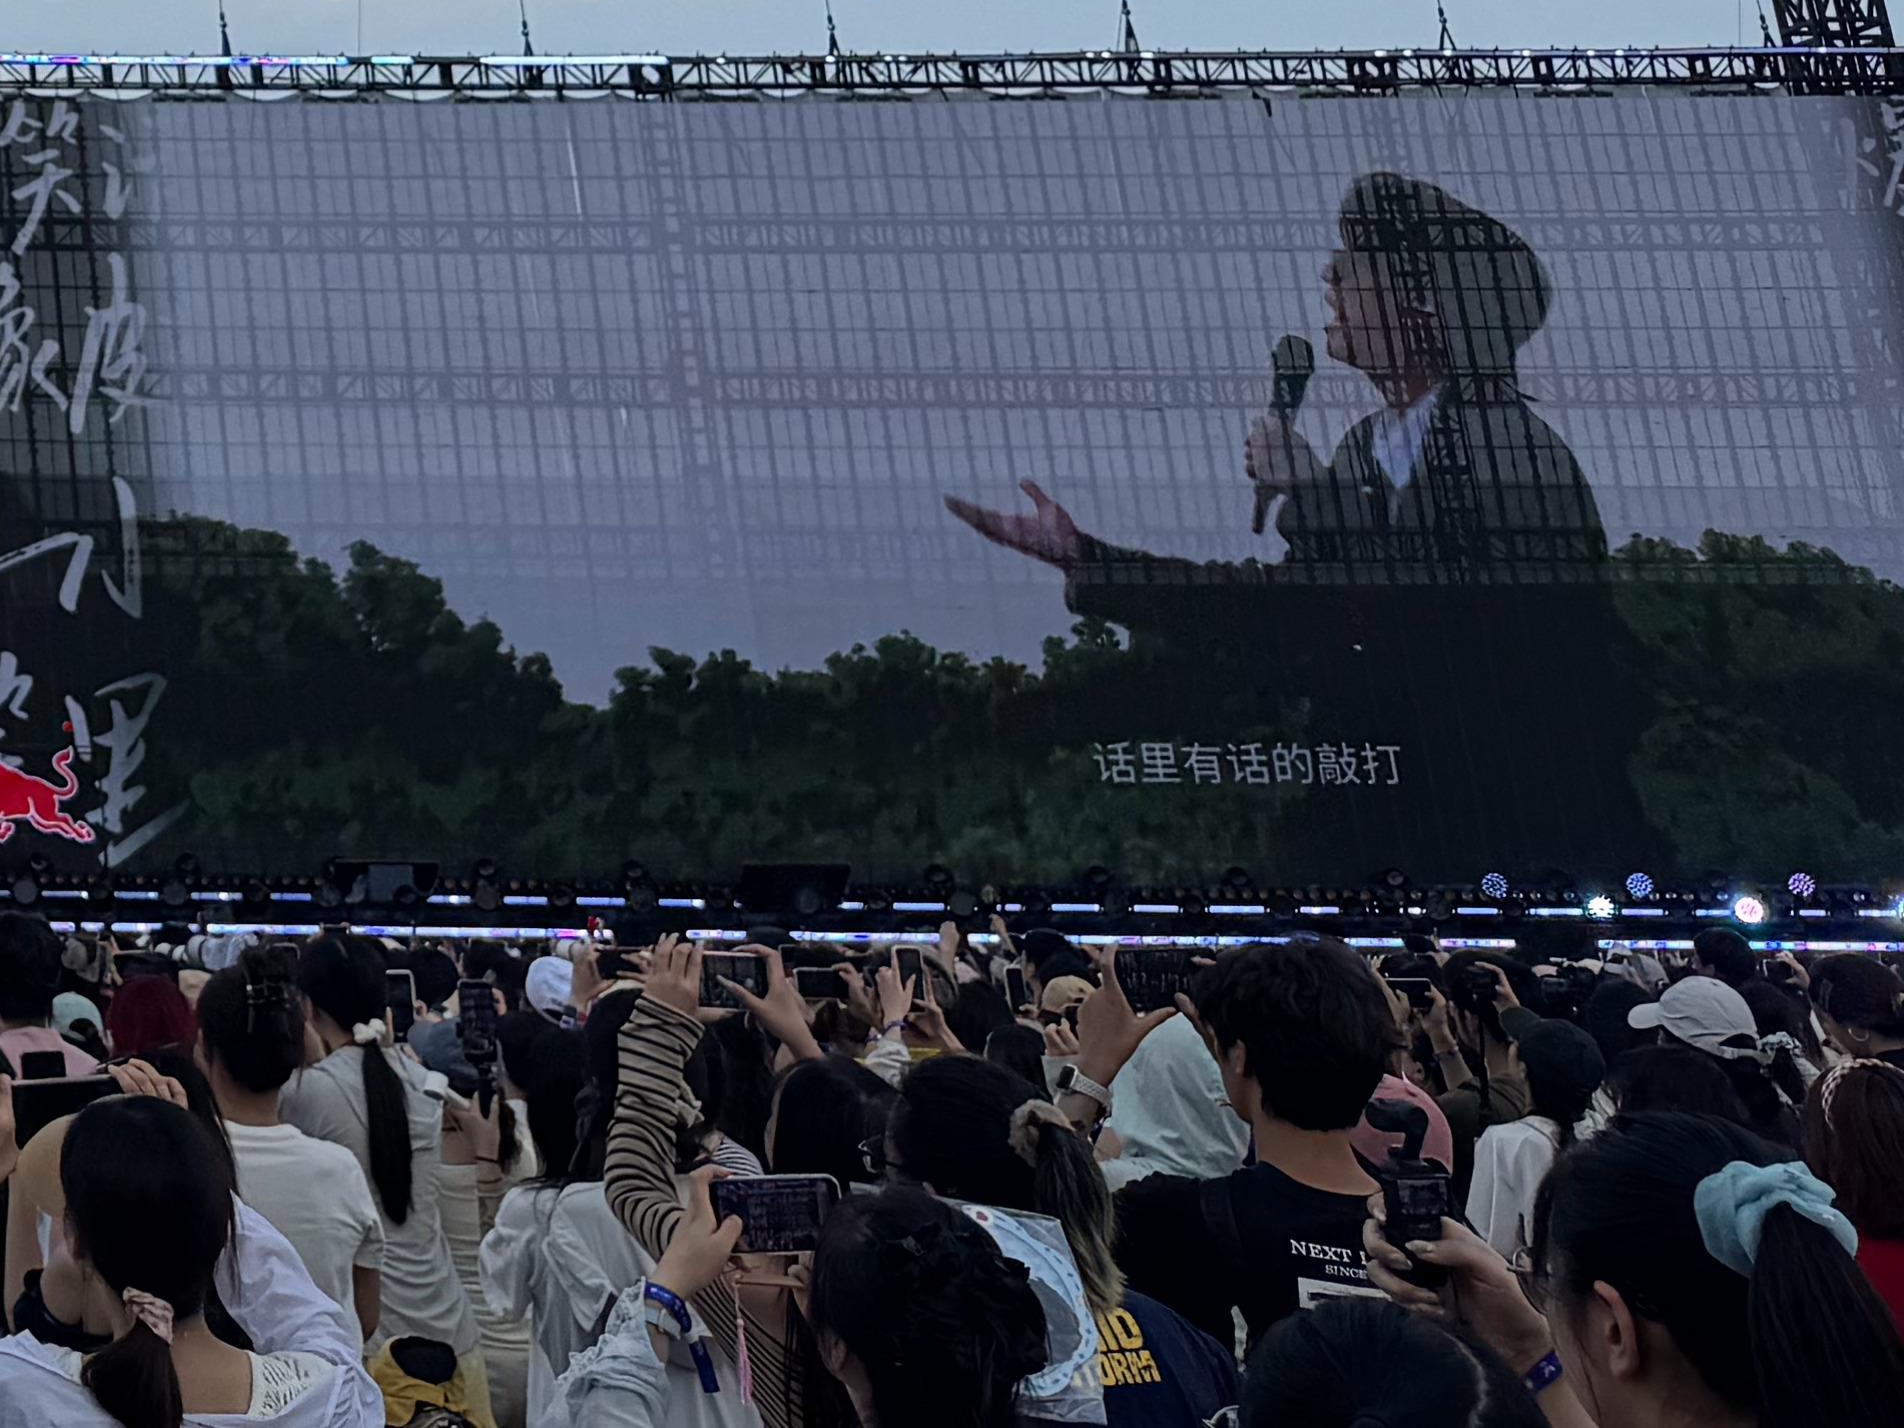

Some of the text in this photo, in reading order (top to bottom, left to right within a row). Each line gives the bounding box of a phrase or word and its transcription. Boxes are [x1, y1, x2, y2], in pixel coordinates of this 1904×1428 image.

[1093, 741, 1402, 786] 话里有话的敲打
[1290, 1239, 1352, 1263] NEXT
[1325, 1264, 1368, 1280] SINCE
